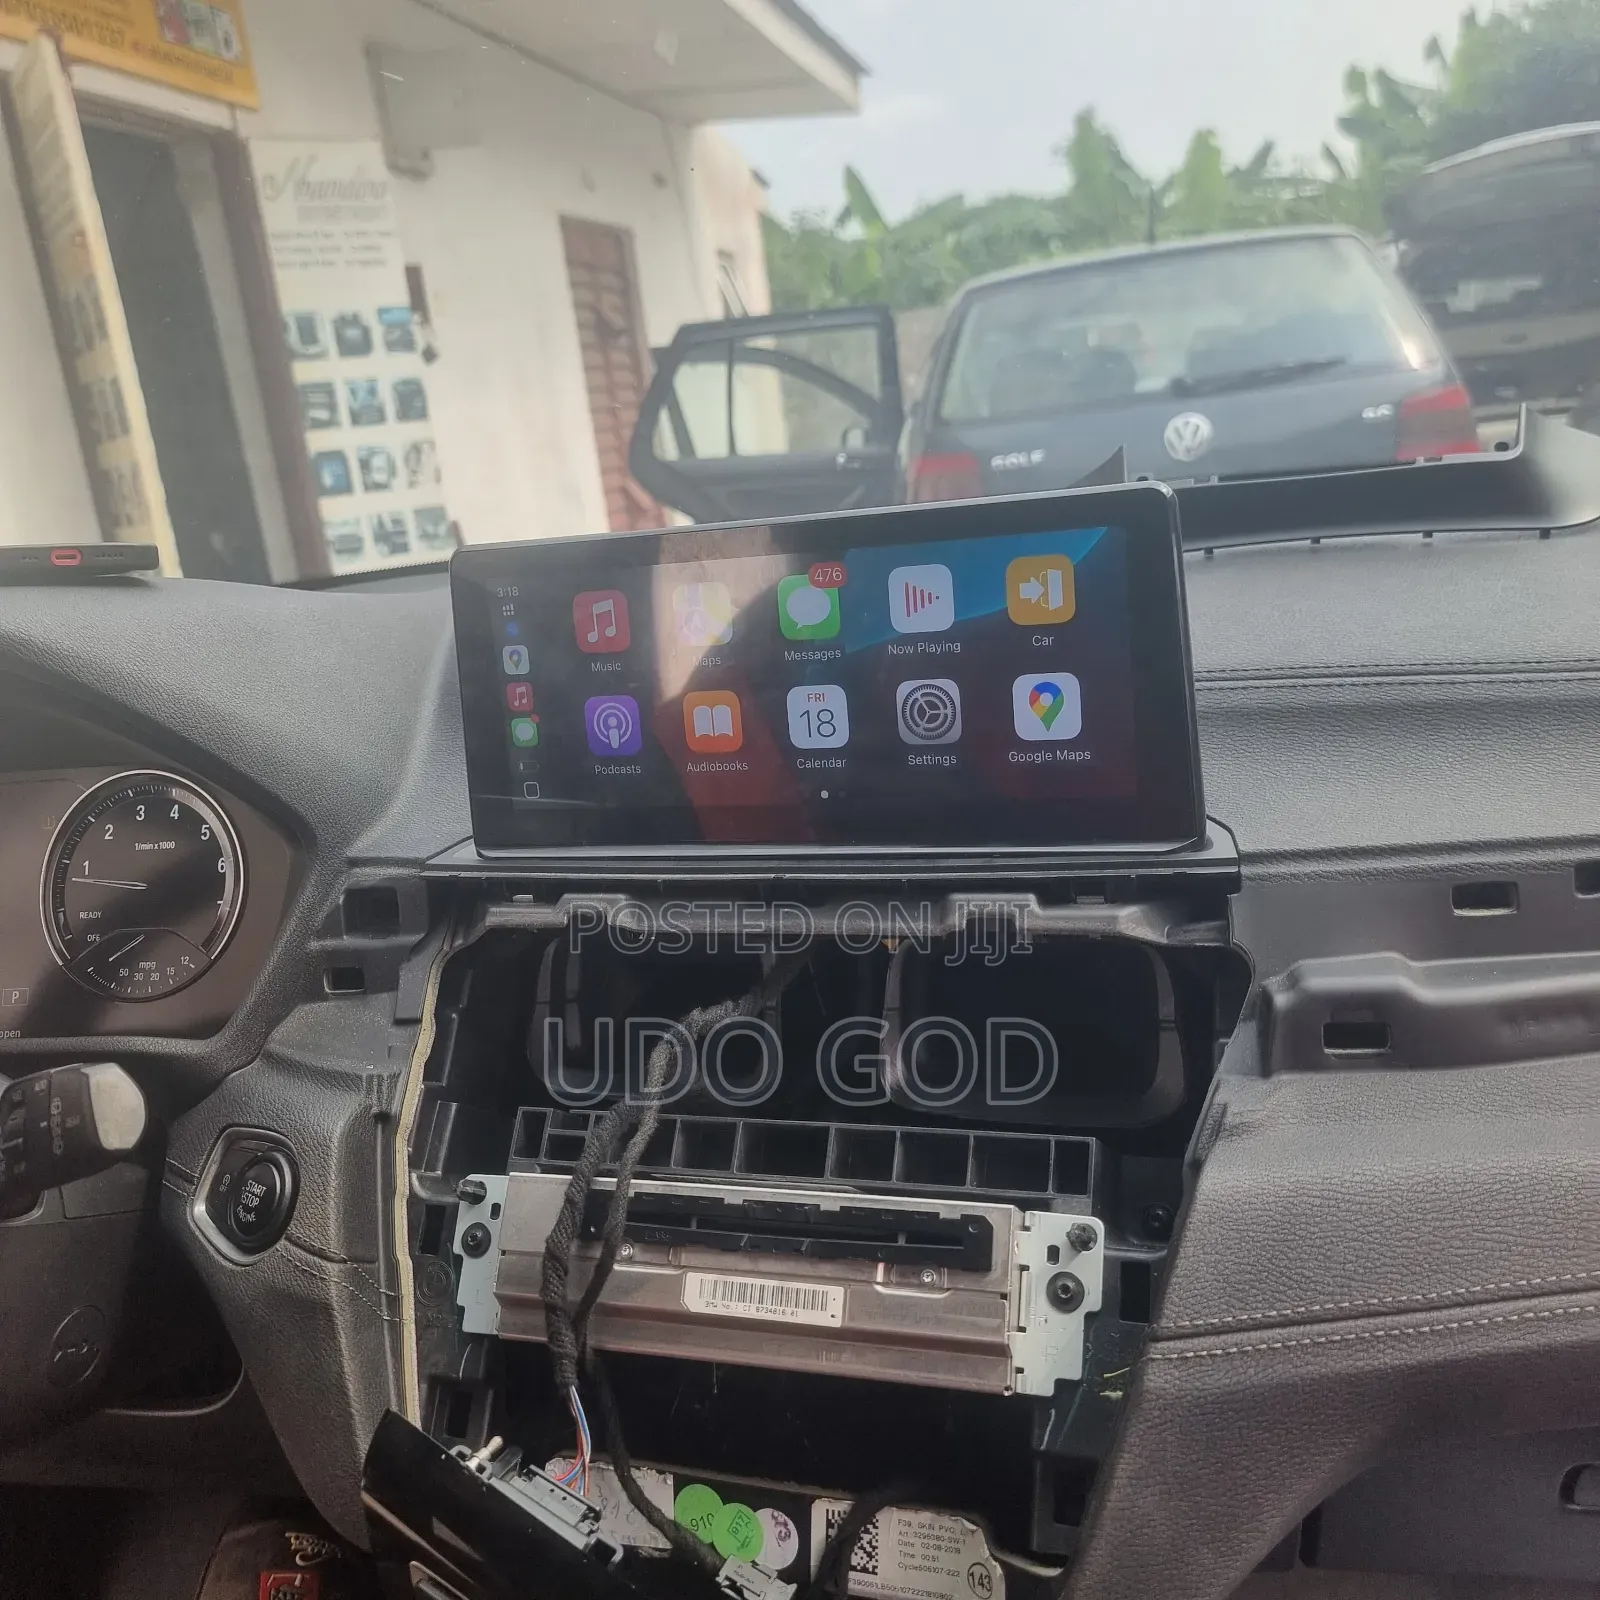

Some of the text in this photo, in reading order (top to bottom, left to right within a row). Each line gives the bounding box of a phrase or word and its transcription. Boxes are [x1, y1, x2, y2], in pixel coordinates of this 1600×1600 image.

[813, 566, 843, 583] 476
[496, 586, 519, 598] 3:18
[888, 640, 961, 655] Now Playing
[1032, 634, 1055, 647] Car
[692, 654, 722, 669] Maps
[784, 648, 842, 662] Messages
[591, 660, 622, 673] Music
[807, 692, 826, 703] FRI
[799, 708, 837, 738] 18
[796, 757, 847, 770] Calendar
[907, 753, 957, 767] Settings
[1008, 749, 1091, 765] Google Maps
[594, 763, 642, 776] Podcasts
[686, 759, 749, 773] Audiobooks
[135, 804, 146, 821] 3
[169, 804, 180, 820] 4
[104, 824, 114, 840] 2
[200, 824, 210, 841] 5
[83, 860, 90, 876] 1
[217, 857, 227, 874] 6
[79, 911, 102, 919] READY
[138, 960, 157, 971] mpg
[180, 956, 190, 966] 12
[119, 968, 129, 977] 50
[133, 972, 144, 981] 30
[150, 972, 160, 981] 20
[166, 967, 176, 976] 15
[11, 990, 20, 1004] P
[245, 1180, 267, 1197] START
[242, 1192, 260, 1208] STOP
[236, 1205, 257, 1223] ENGINE
[897, 1538, 915, 1548] Date
[898, 1549, 916, 1559] Time
[968, 1571, 992, 1592] 143
